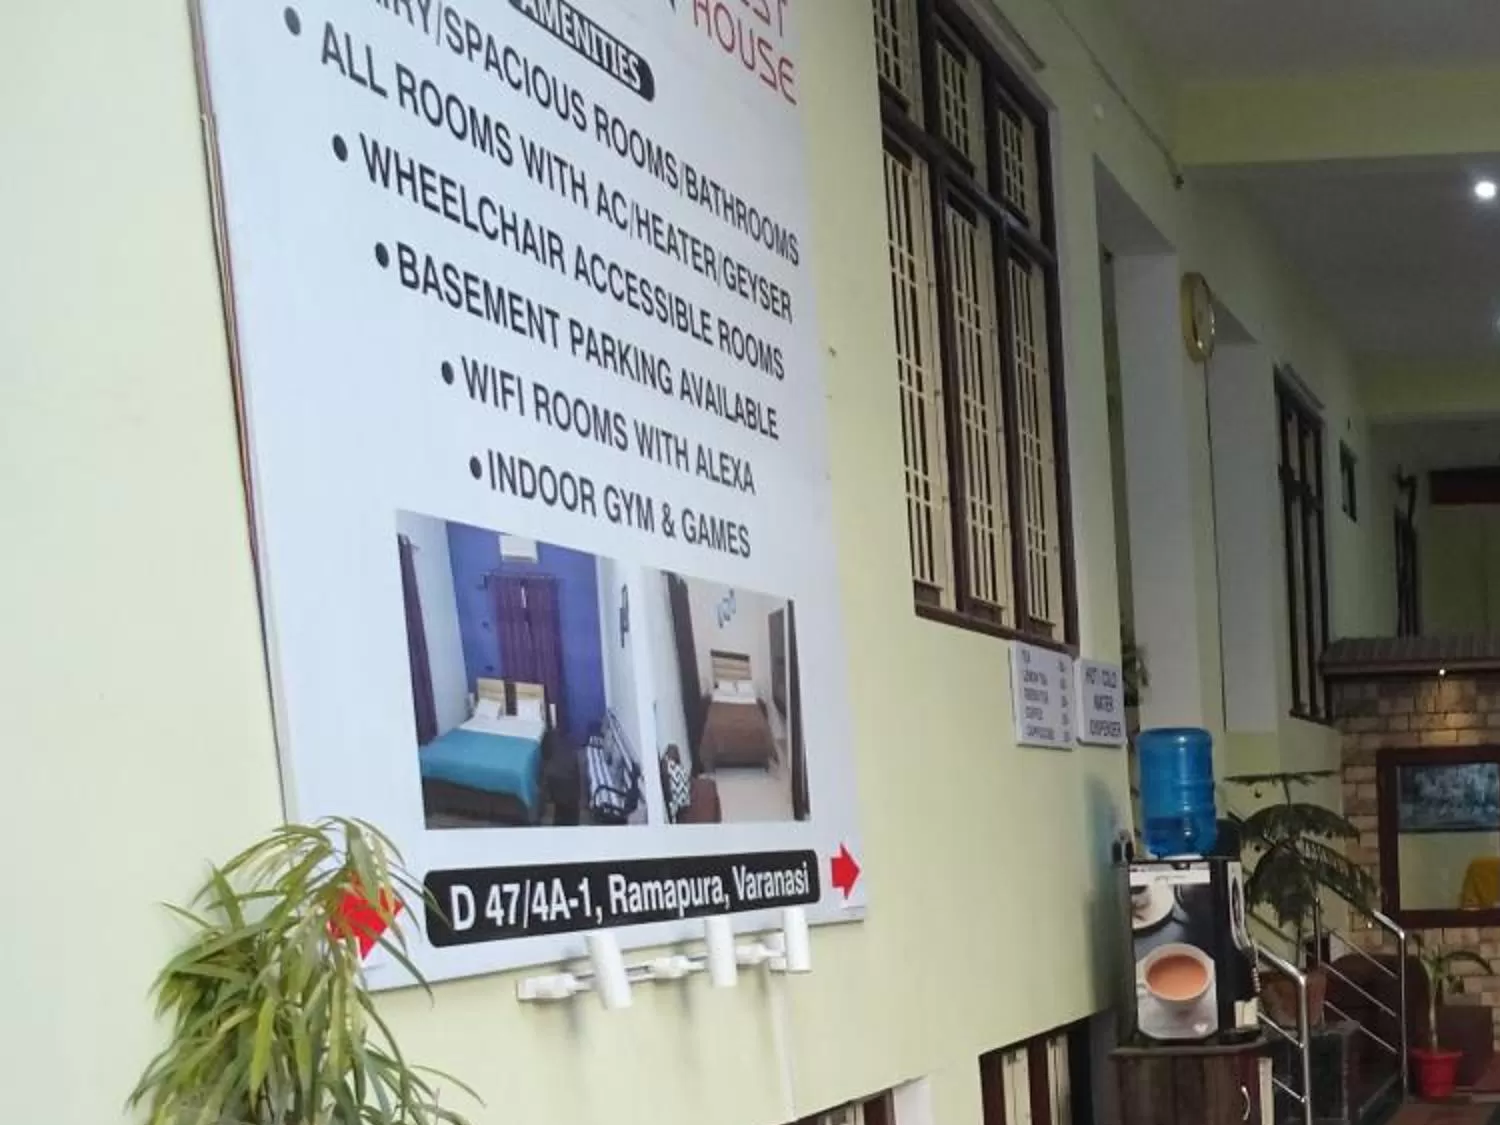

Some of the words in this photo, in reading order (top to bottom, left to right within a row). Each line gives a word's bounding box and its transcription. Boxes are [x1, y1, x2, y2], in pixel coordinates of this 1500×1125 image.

[693, 0, 797, 106] HOUSE
[321, 20, 388, 99] ALL
[395, 61, 513, 167] ROOMS
[520, 134, 588, 209] WITH
[597, 180, 793, 324] AC/HEATER/GEYSER
[594, 103, 799, 267] ROOMS/BATHROOMS
[359, 132, 566, 275] WHEELCHAIR
[574, 244, 714, 346] ACCESSIBLE
[717, 317, 785, 381] ROOMS
[396, 241, 560, 349] BASEMENT
[568, 318, 674, 396] PARKING
[680, 368, 780, 441] AVAILABLE
[461, 355, 526, 417] WIFI
[533, 382, 629, 451] ROOMS
[634, 419, 690, 473] WITH
[695, 444, 757, 496] ALEXA
[487, 448, 597, 518] INDOOR
[604, 484, 655, 534] GYM
[660, 502, 676, 538] &
[681, 508, 751, 559] GAMES
[450, 884, 476, 931] D
[485, 877, 603, 928] 47/4A-1,
[608, 871, 730, 918] Ramapura,
[732, 861, 811, 902] Varanasi
